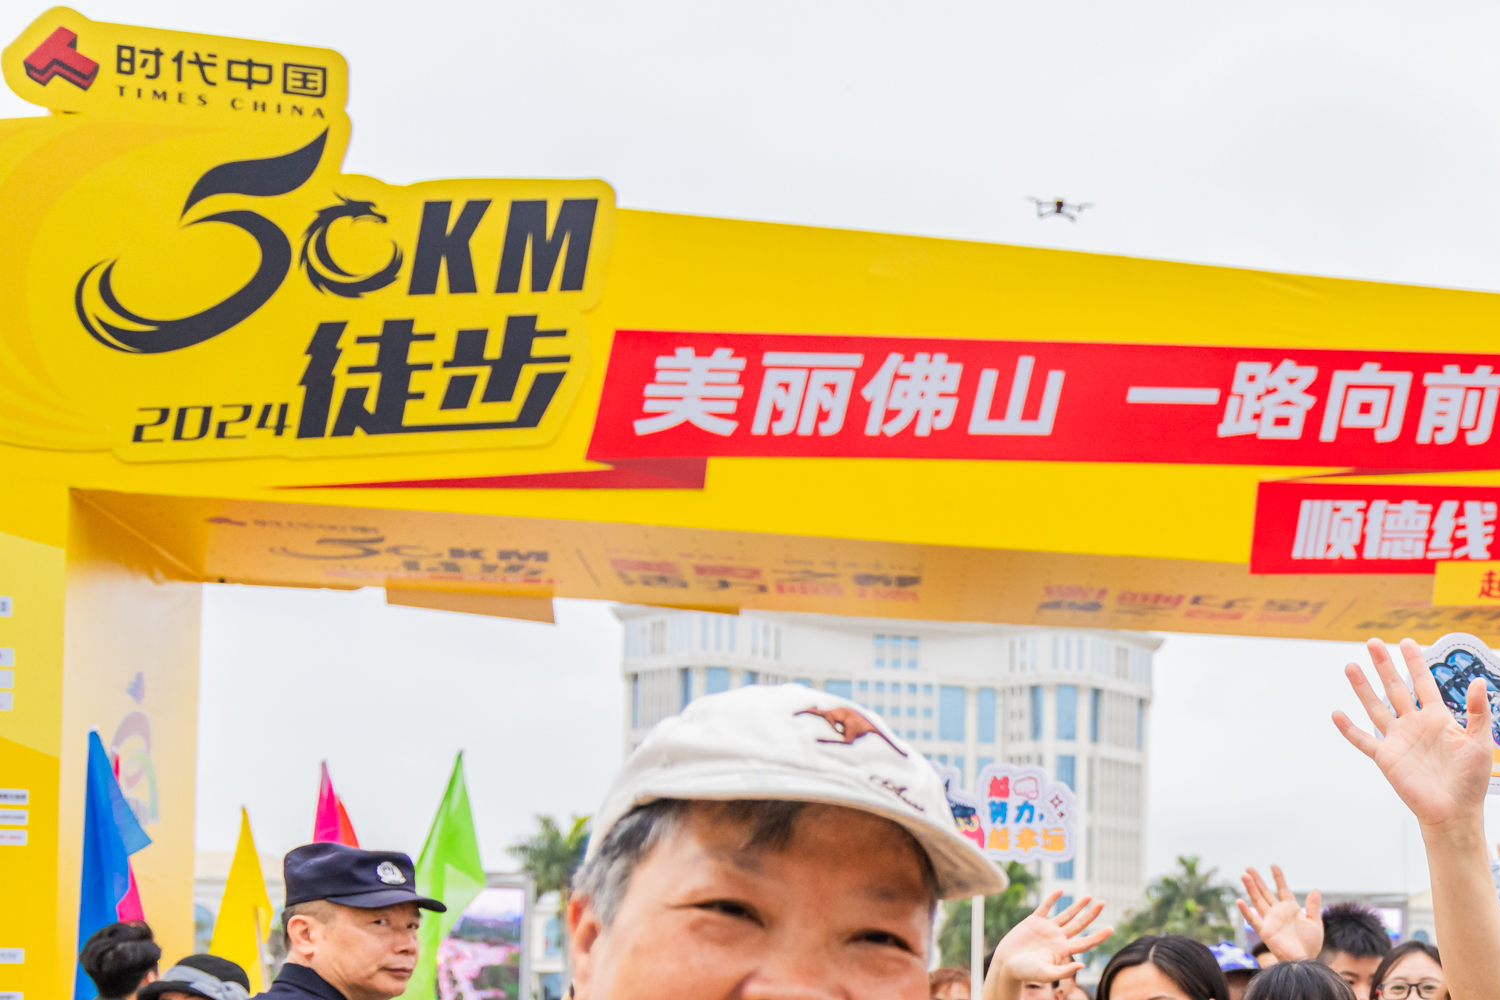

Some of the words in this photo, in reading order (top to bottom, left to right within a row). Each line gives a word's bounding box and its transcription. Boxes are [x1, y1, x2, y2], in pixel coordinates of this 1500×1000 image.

[116, 44, 328, 99] 时代中国
[116, 85, 209, 107] TIMES
[230, 98, 327, 119] CHINA
[133, 402, 291, 443] 2024
[297, 314, 571, 439] 徒步
[633, 347, 1066, 437] 美丽佛山
[1291, 499, 1498, 561] 顺德线
